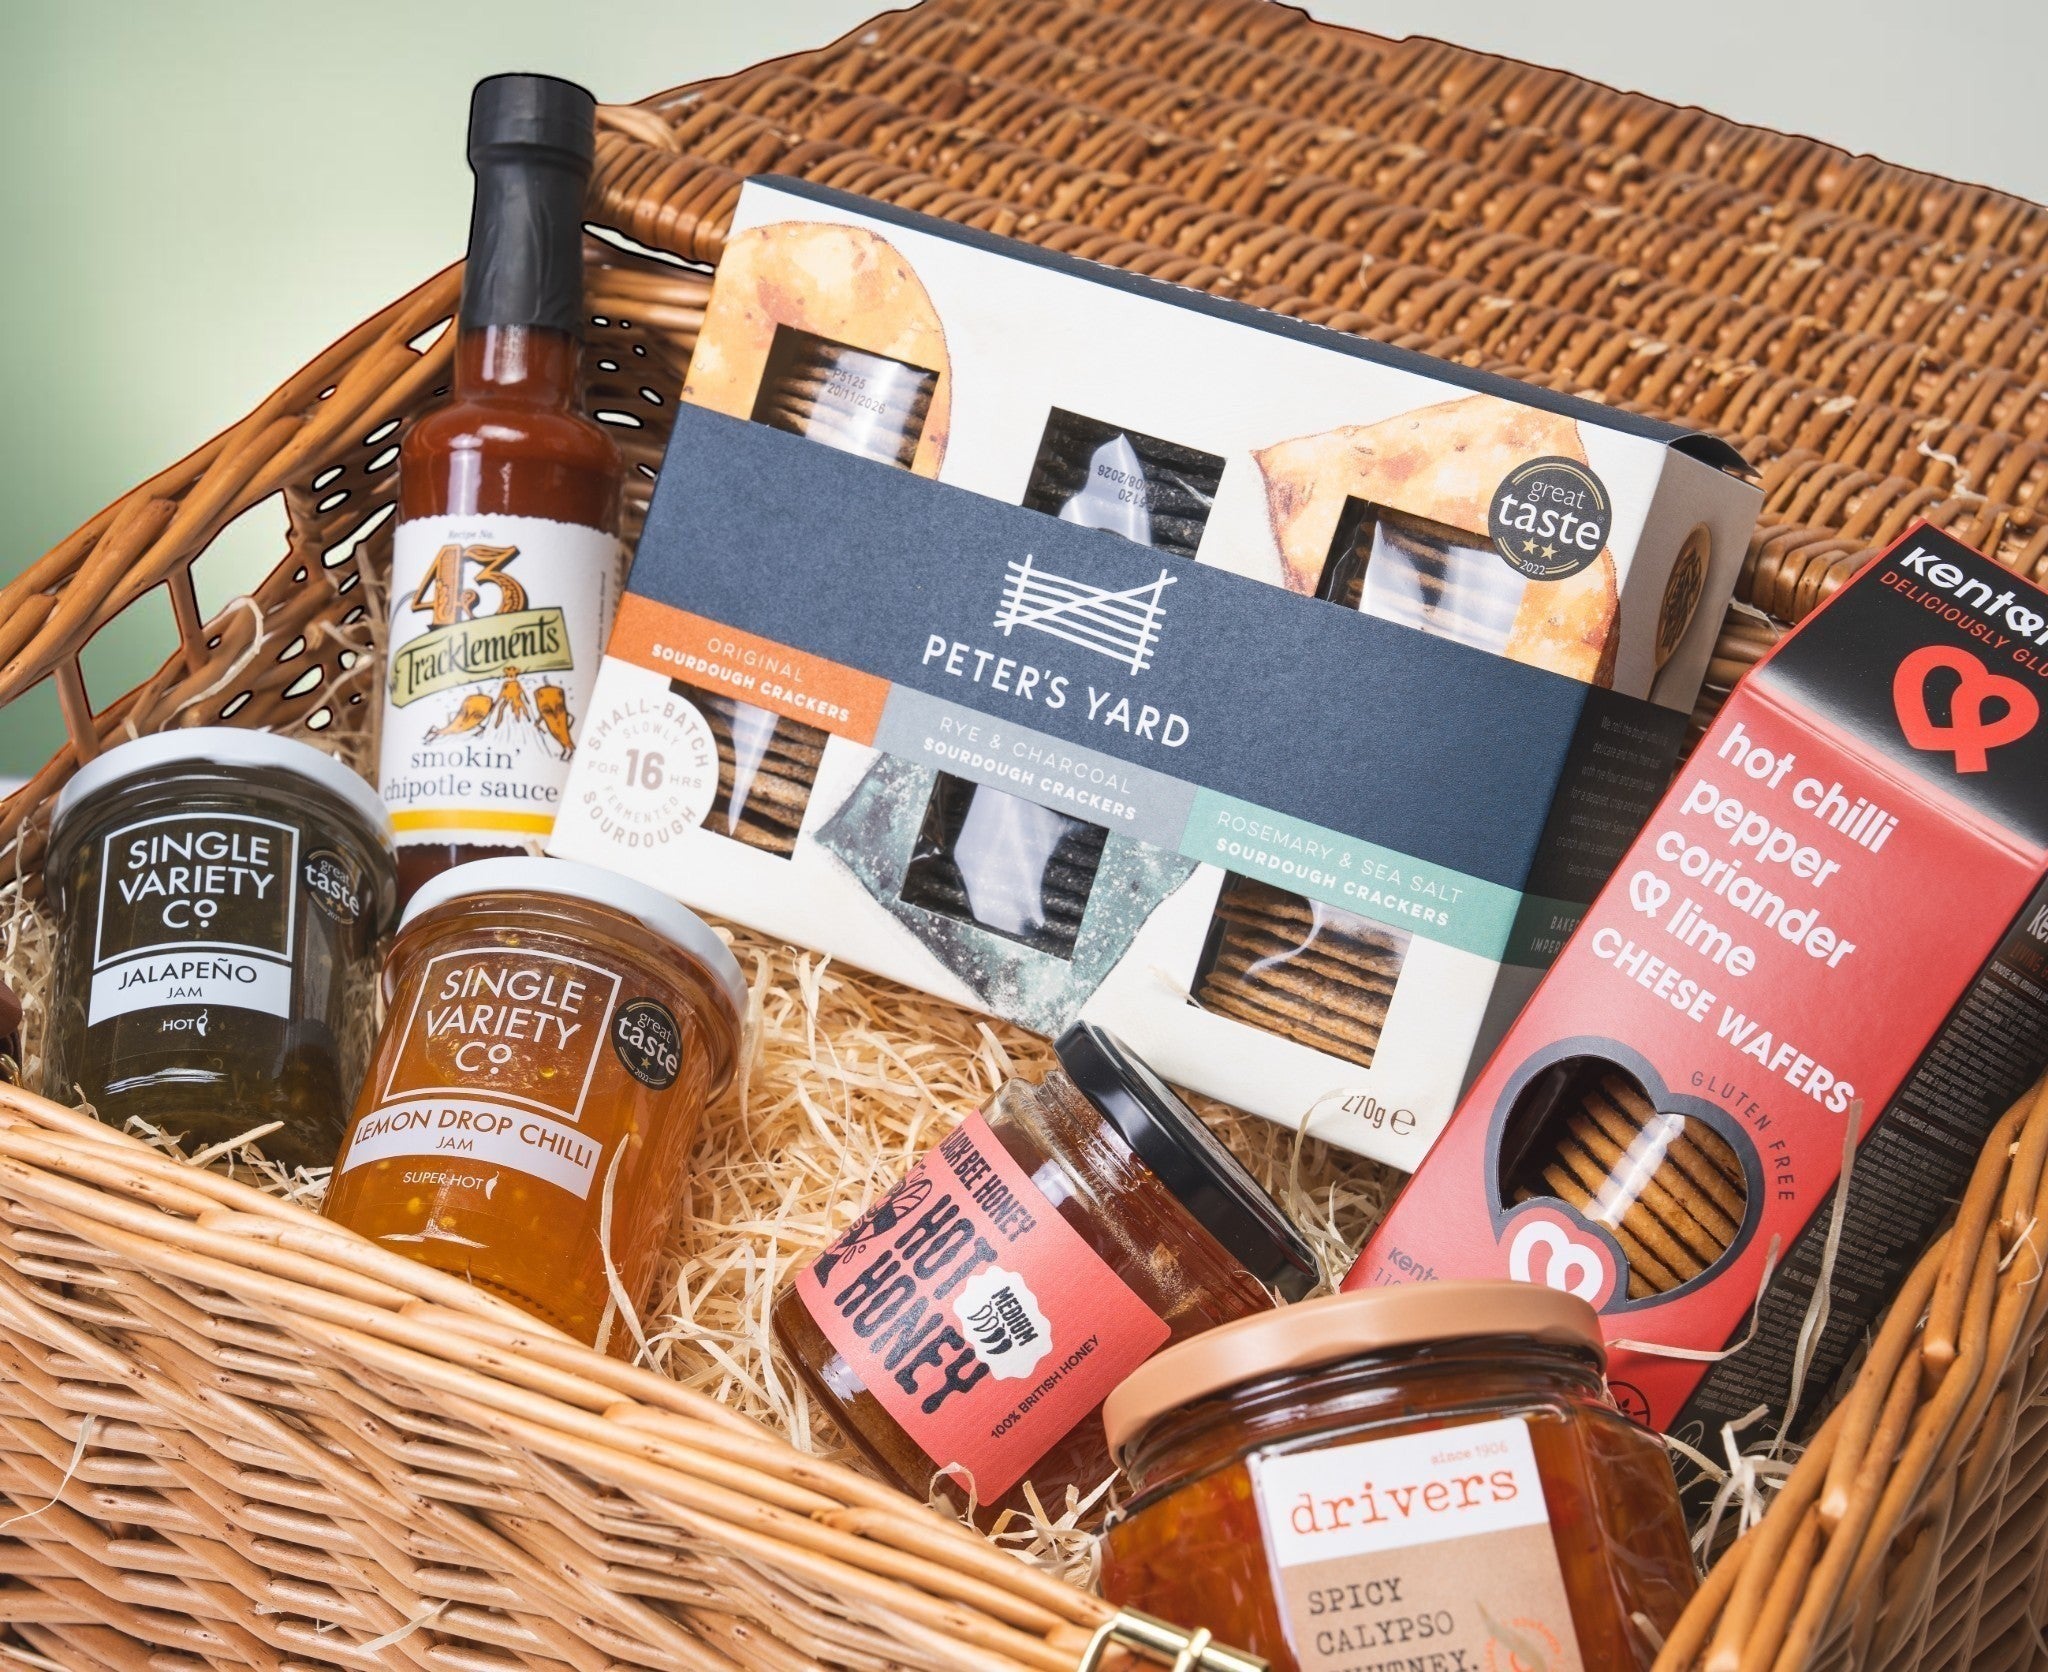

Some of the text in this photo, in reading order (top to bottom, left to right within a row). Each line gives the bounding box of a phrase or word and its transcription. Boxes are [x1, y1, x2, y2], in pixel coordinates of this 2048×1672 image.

[827, 382, 886, 414] 20/11/2026
[833, 368, 867, 390] P5125
[1527, 481, 1586, 509] great
[1498, 493, 1601, 551] taste
[411, 543, 529, 627] 43
[1520, 560, 1546, 576] 2022
[1880, 570, 2011, 649] DELICIOUSLY
[394, 613, 562, 697] Tracklements
[706, 637, 804, 683] ORIGINAL
[652, 643, 850, 722] SOURDOUGH CRACKERS
[922, 634, 1190, 748] PETER'S YARD
[588, 698, 709, 768] SMALL-BATCH
[622, 721, 680, 746] SLOWLY
[939, 716, 1131, 795] RYE & CHARCOAL
[384, 774, 559, 803] chipotle sauce
[587, 749, 702, 790] FOR 16 HRS
[923, 736, 1137, 821] SOURDOUGH CRACKERS
[1716, 722, 1899, 854] hot chilli
[583, 791, 696, 848] SOURDOUGH
[603, 785, 679, 824] FERMENTED
[127, 831, 270, 870] SINGLE
[1217, 811, 1463, 905] ROSEMARY & SEA SALT
[1679, 778, 1841, 888] pepper
[118, 865, 275, 905] VARIETY
[304, 864, 360, 917] taste
[321, 860, 350, 887] great
[1216, 837, 1450, 927] SOURDOUGH CRACKERS
[1655, 830, 1857, 969] coriander
[1665, 897, 1756, 977] lime
[118, 958, 258, 991] JALAPEÑO
[166, 986, 203, 999] JAM
[439, 967, 587, 1014] SINGLE
[162, 1018, 193, 1032] HOT
[426, 1005, 583, 1051] VARIETY
[618, 1016, 678, 1076] taste
[637, 1013, 672, 1043] great
[1591, 927, 1717, 1024] CHEESE
[1716, 1005, 1856, 1114] WAFERS
[634, 1068, 650, 1083] 2022
[1691, 1070, 1772, 1131] GLUTEN
[1341, 1095, 1386, 1129] 270g
[355, 1109, 593, 1170] LEMON DROP CHILLI
[435, 1136, 473, 1151] JAM
[402, 1171, 484, 1191] SUPER HOT
[953, 1149, 992, 1191] BEE
[1769, 1139, 1795, 1200] FREE
[972, 1174, 1037, 1242] HONEY
[894, 1193, 998, 1300] HOT
[1375, 1267, 1401, 1286] 11
[834, 1250, 990, 1414] HONEY
[990, 1286, 1039, 1346] MEDIUM
[990, 1335, 1100, 1439] 100% BRITISH HONEY
[1430, 1448, 1472, 1465] since
[1290, 1468, 1519, 1536] drivers
[1307, 1577, 1403, 1616] SPICY
[1316, 1609, 1455, 1656] CALYPSO
